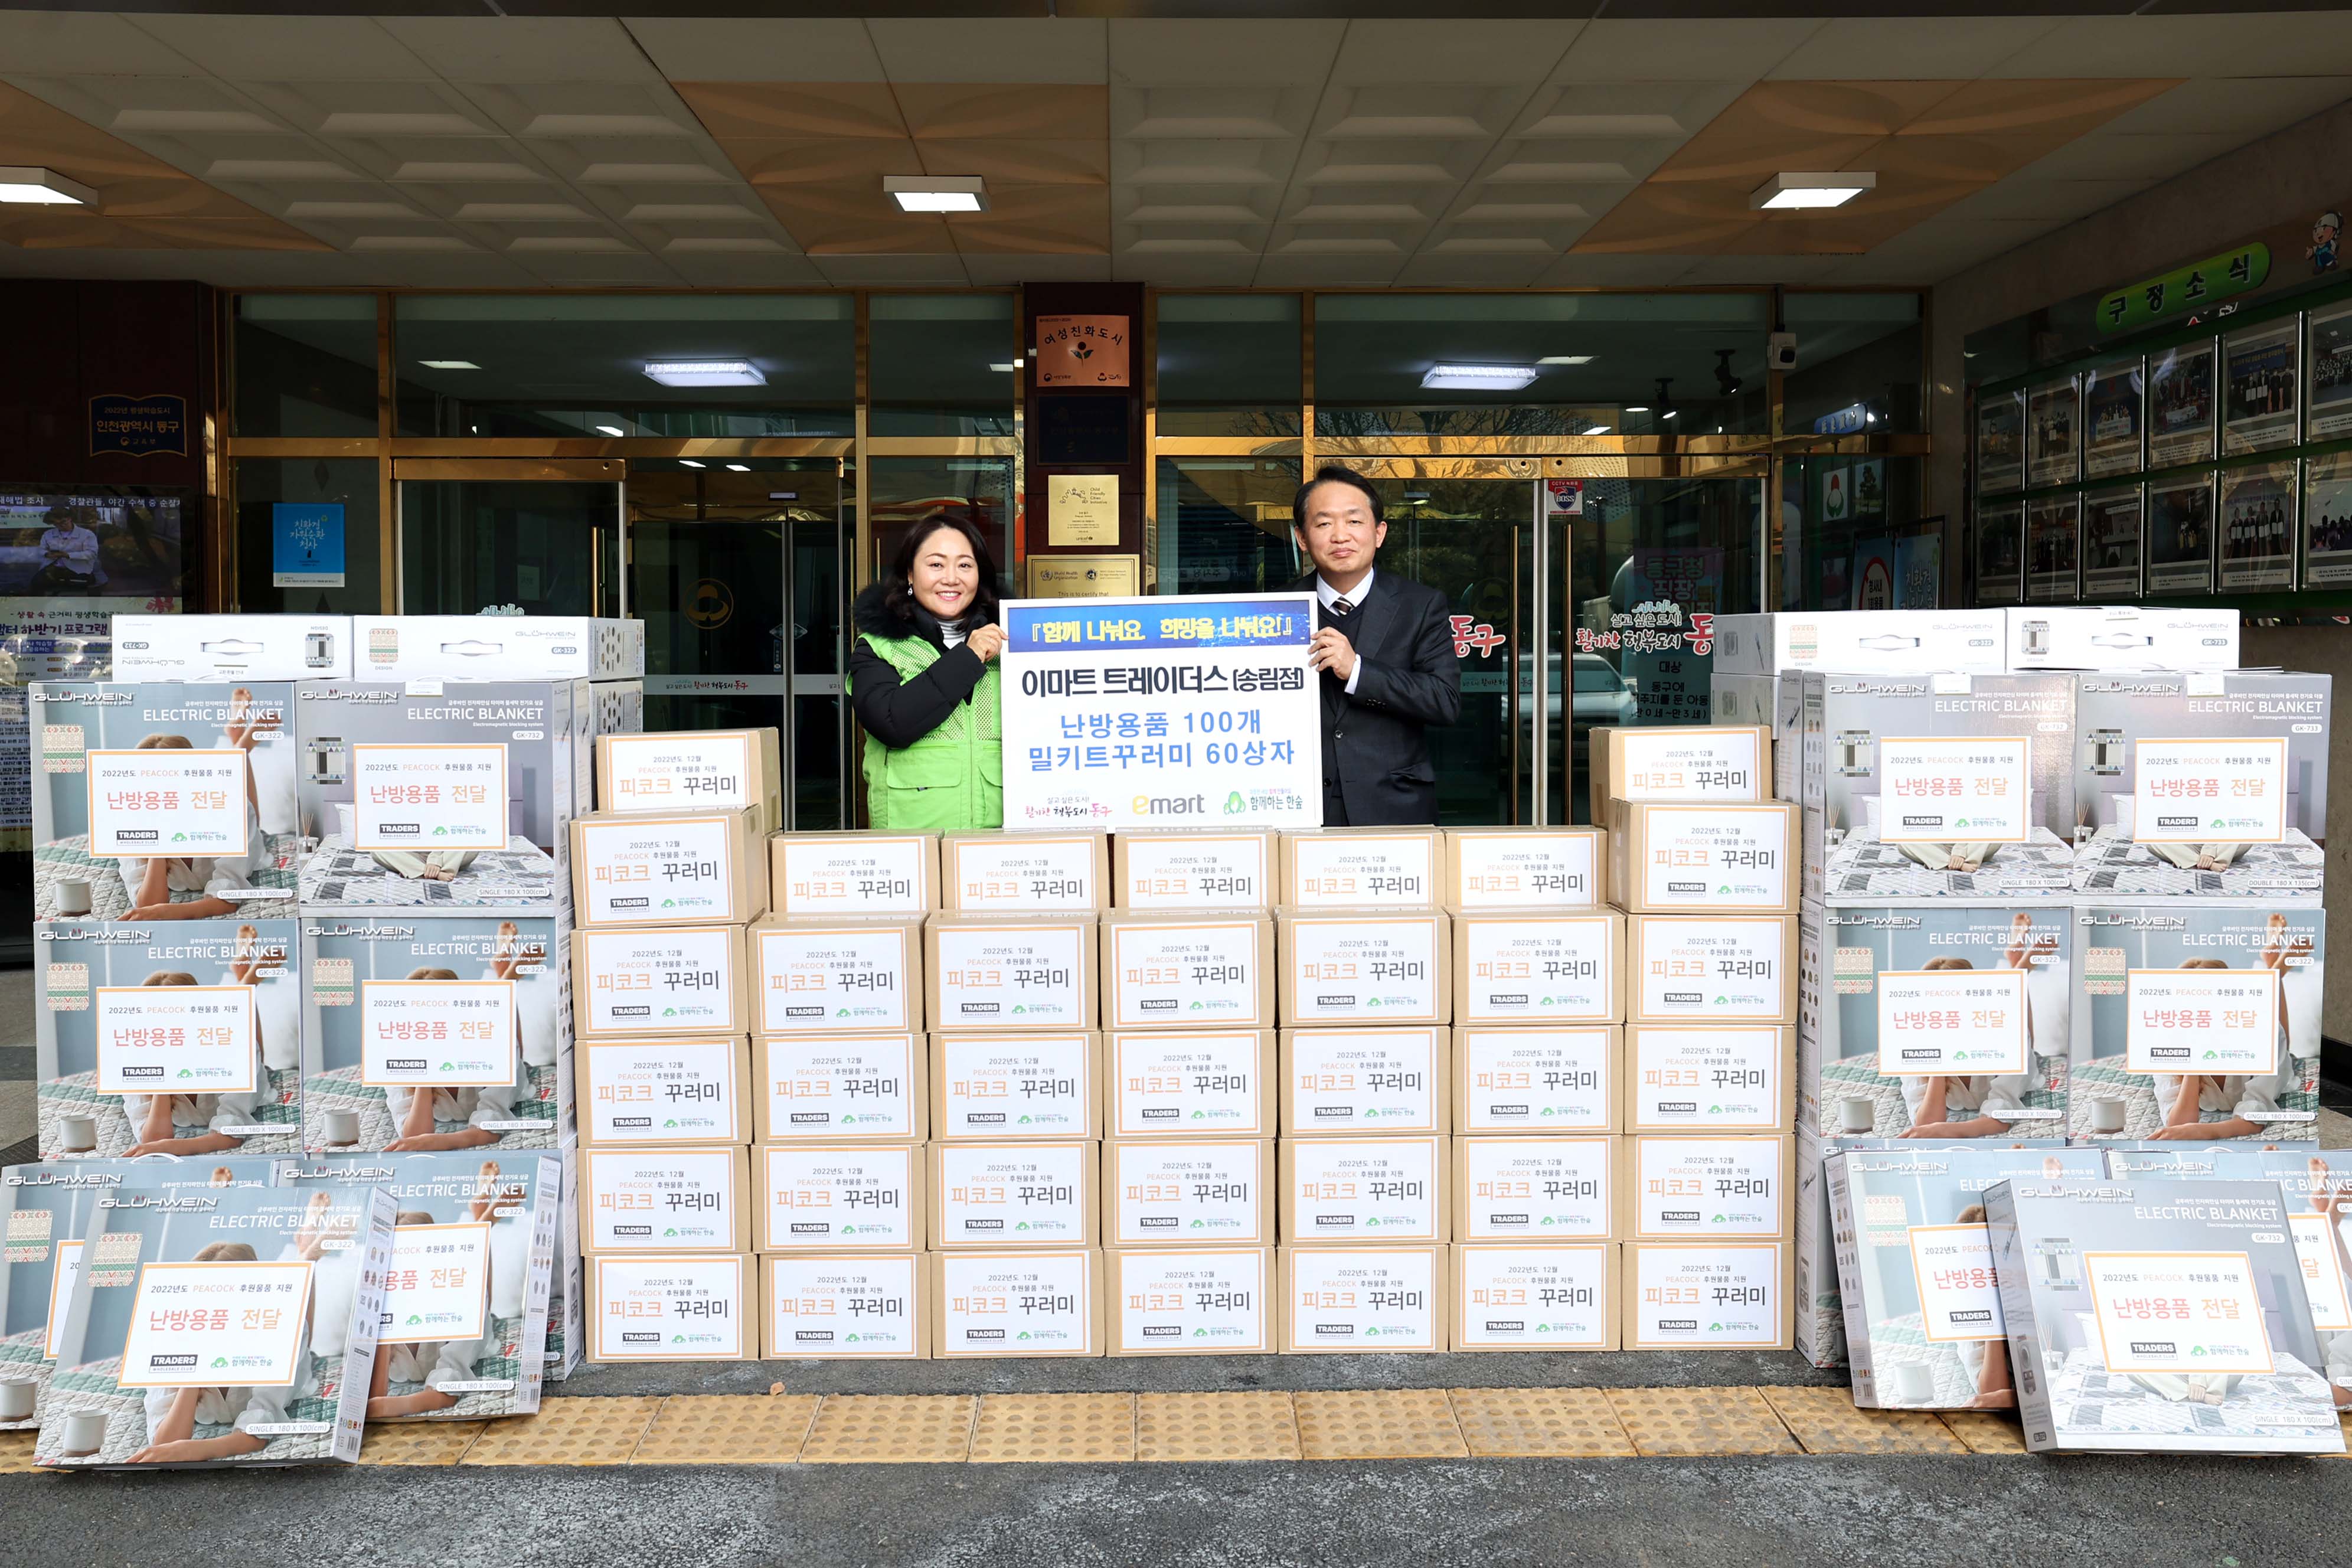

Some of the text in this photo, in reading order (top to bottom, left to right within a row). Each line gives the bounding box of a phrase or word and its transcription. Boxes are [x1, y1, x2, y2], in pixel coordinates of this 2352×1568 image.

[2109, 252, 2251, 325] 구정소식
[1044, 325, 1123, 345] 여성친화도시
[96, 420, 180, 433] 인천광역시 동구
[27, 496, 44, 505] 조사
[108, 497, 125, 507] 야간
[128, 497, 145, 507] 수색
[294, 519, 321, 530] 친환경
[289, 529, 325, 540] 자원순환
[299, 538, 318, 550] 청사
[1906, 562, 1932, 593] 친환경
[1611, 613, 1682, 627] 살고 싶은 도시!
[21, 623, 107, 635] 하반기 프로그램
[1161, 618, 1215, 639] 희망을
[1449, 615, 1506, 658] 동구
[1576, 628, 1621, 652] 활기찬
[1623, 629, 1681, 653] 행복도시
[1659, 661, 1681, 673] 대상
[734, 680, 748, 690] 동구
[1023, 668, 1097, 698] 이마트
[1103, 665, 1228, 695] 트레이더스
[1652, 682, 1684, 692] 동구에
[1687, 695, 1708, 706] 아동
[2188, 701, 2323, 713] ELECTRIC BLANKET
[408, 708, 544, 720] ELECTRIC BLANKET
[1060, 709, 1262, 739] 난방용품 100개
[1029, 739, 1295, 771] 밀키트꾸러미 60상자
[370, 785, 487, 804] 난방용품 전달
[620, 776, 736, 797] 피코크 꾸러미
[2150, 779, 2266, 798] 난방용품 전달
[1025, 803, 1113, 818] 활기찬 행복도시 동구
[1132, 793, 1205, 815] emart
[1250, 795, 1303, 811] 함께하는 한숲
[381, 825, 419, 833] TRADERS
[1655, 849, 1775, 869] 피코크 꾸러미
[1127, 965, 1245, 987] 피코크 꾸러미
[782, 1298, 903, 1317] 피코크 꾸러미
